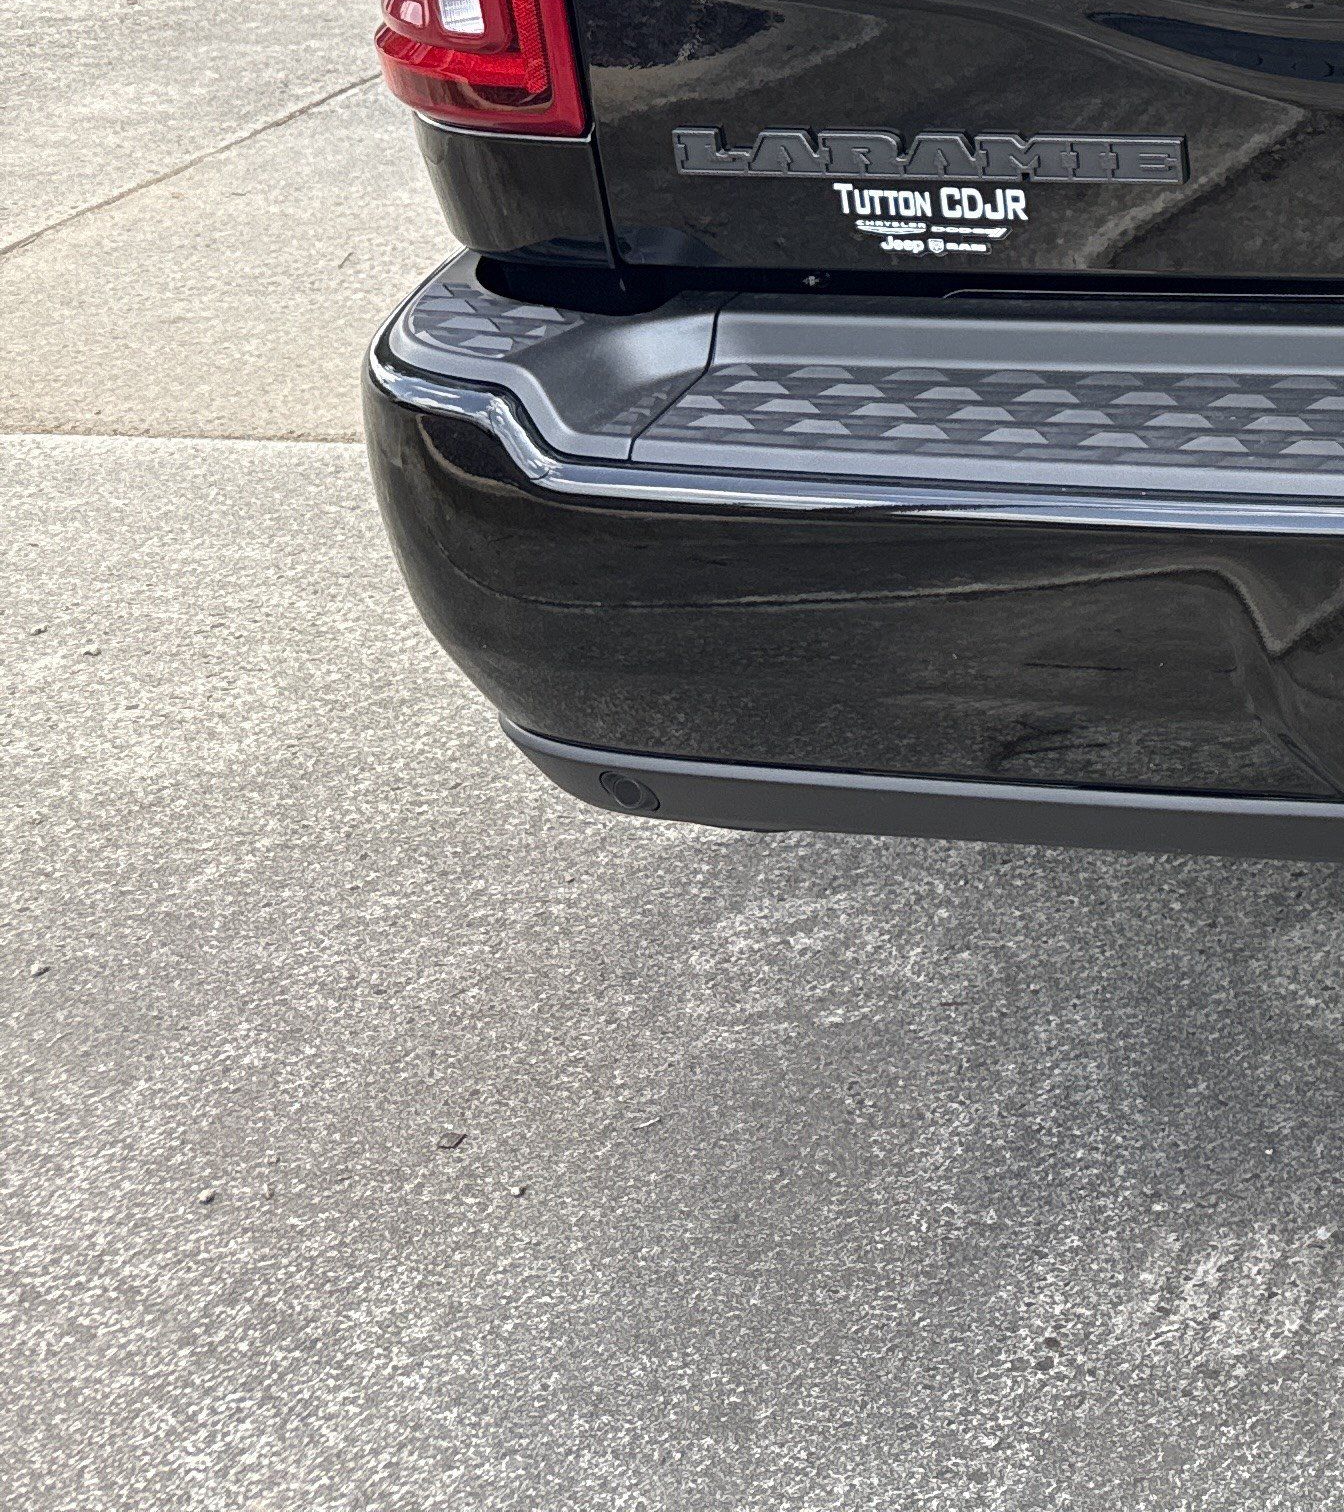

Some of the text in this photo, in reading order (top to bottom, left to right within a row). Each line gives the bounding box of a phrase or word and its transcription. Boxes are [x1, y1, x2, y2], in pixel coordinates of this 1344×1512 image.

[672, 126, 1190, 184] LARAMIE
[940, 187, 1028, 220] CDJR
[880, 236, 925, 254] Jeep
